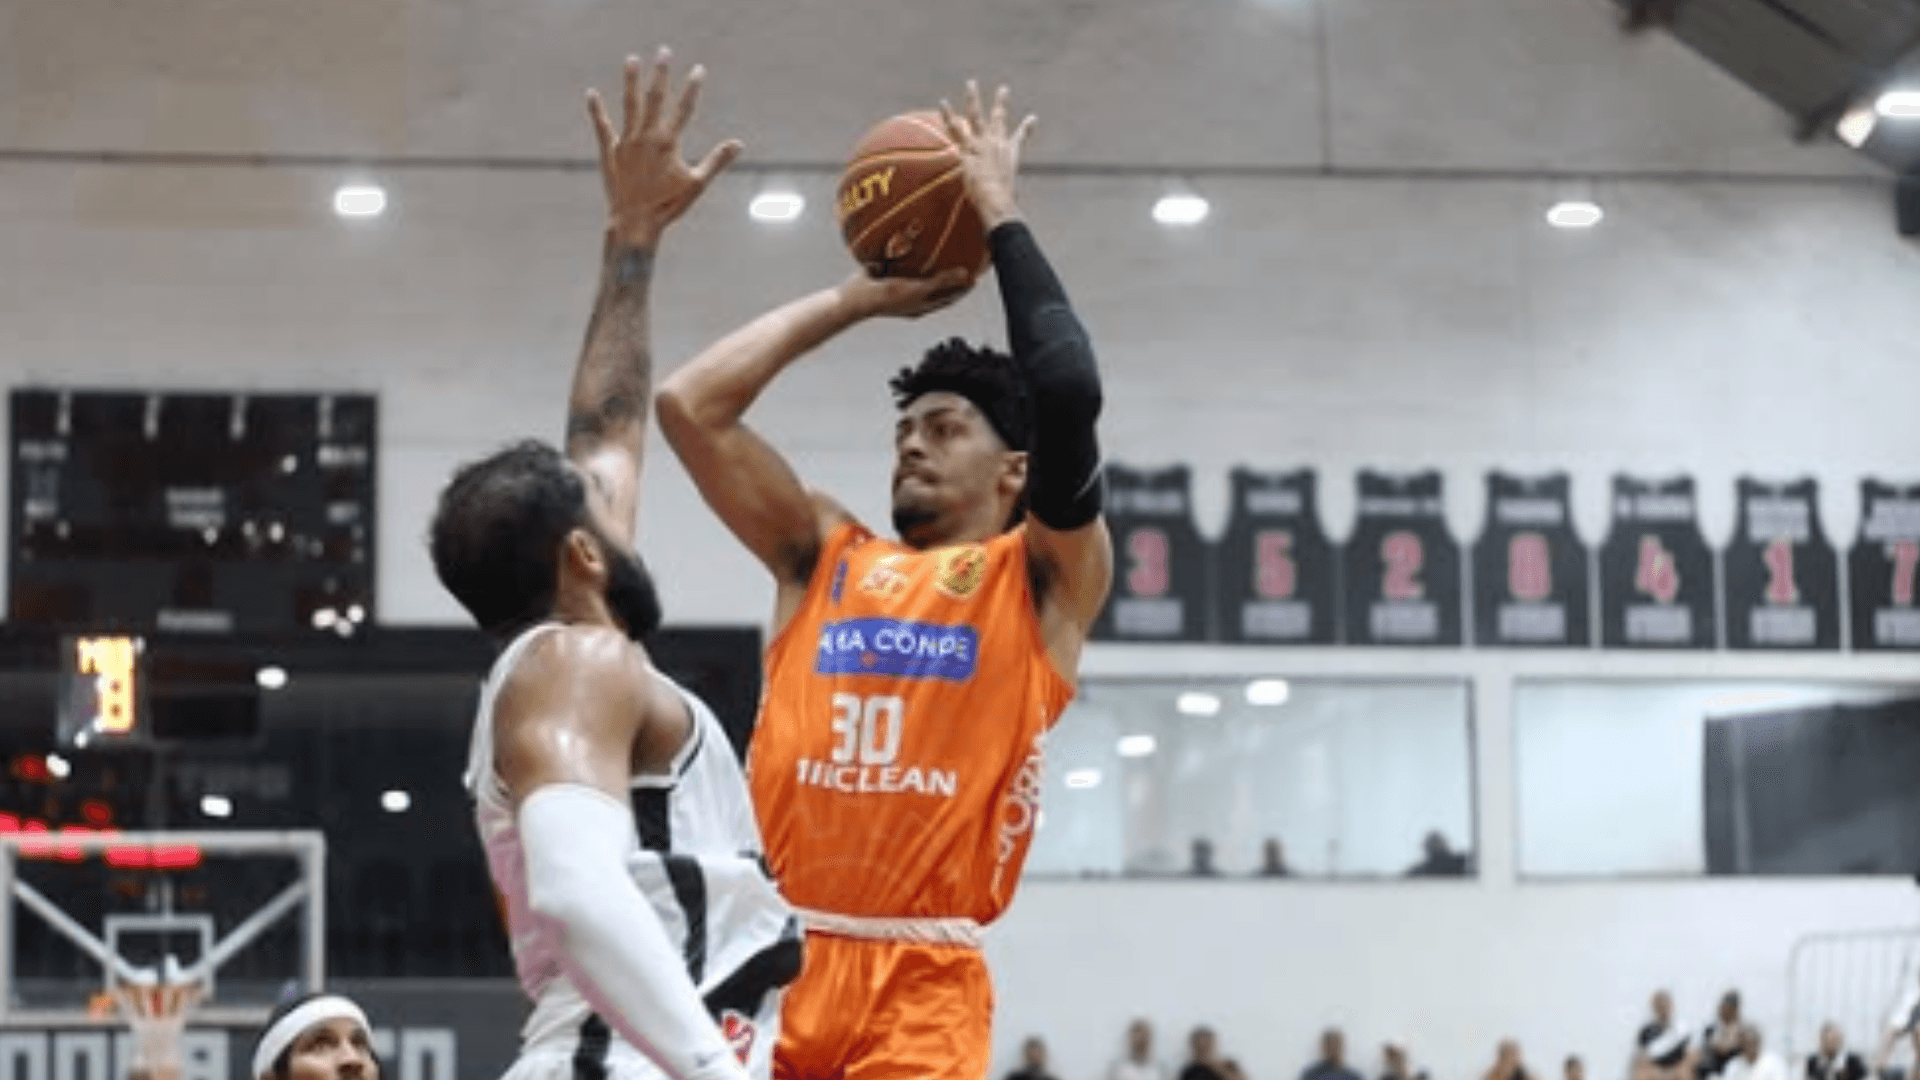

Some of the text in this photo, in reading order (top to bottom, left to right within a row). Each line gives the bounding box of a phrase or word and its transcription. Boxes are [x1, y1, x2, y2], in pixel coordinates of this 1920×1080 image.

[1128, 528, 1168, 597] 3
[1255, 531, 1295, 599] 5
[1381, 530, 1424, 600] 2
[1636, 534, 1678, 604] 4
[1765, 534, 1796, 605] 1
[1884, 540, 1920, 605] 7
[831, 693, 903, 765] 30
